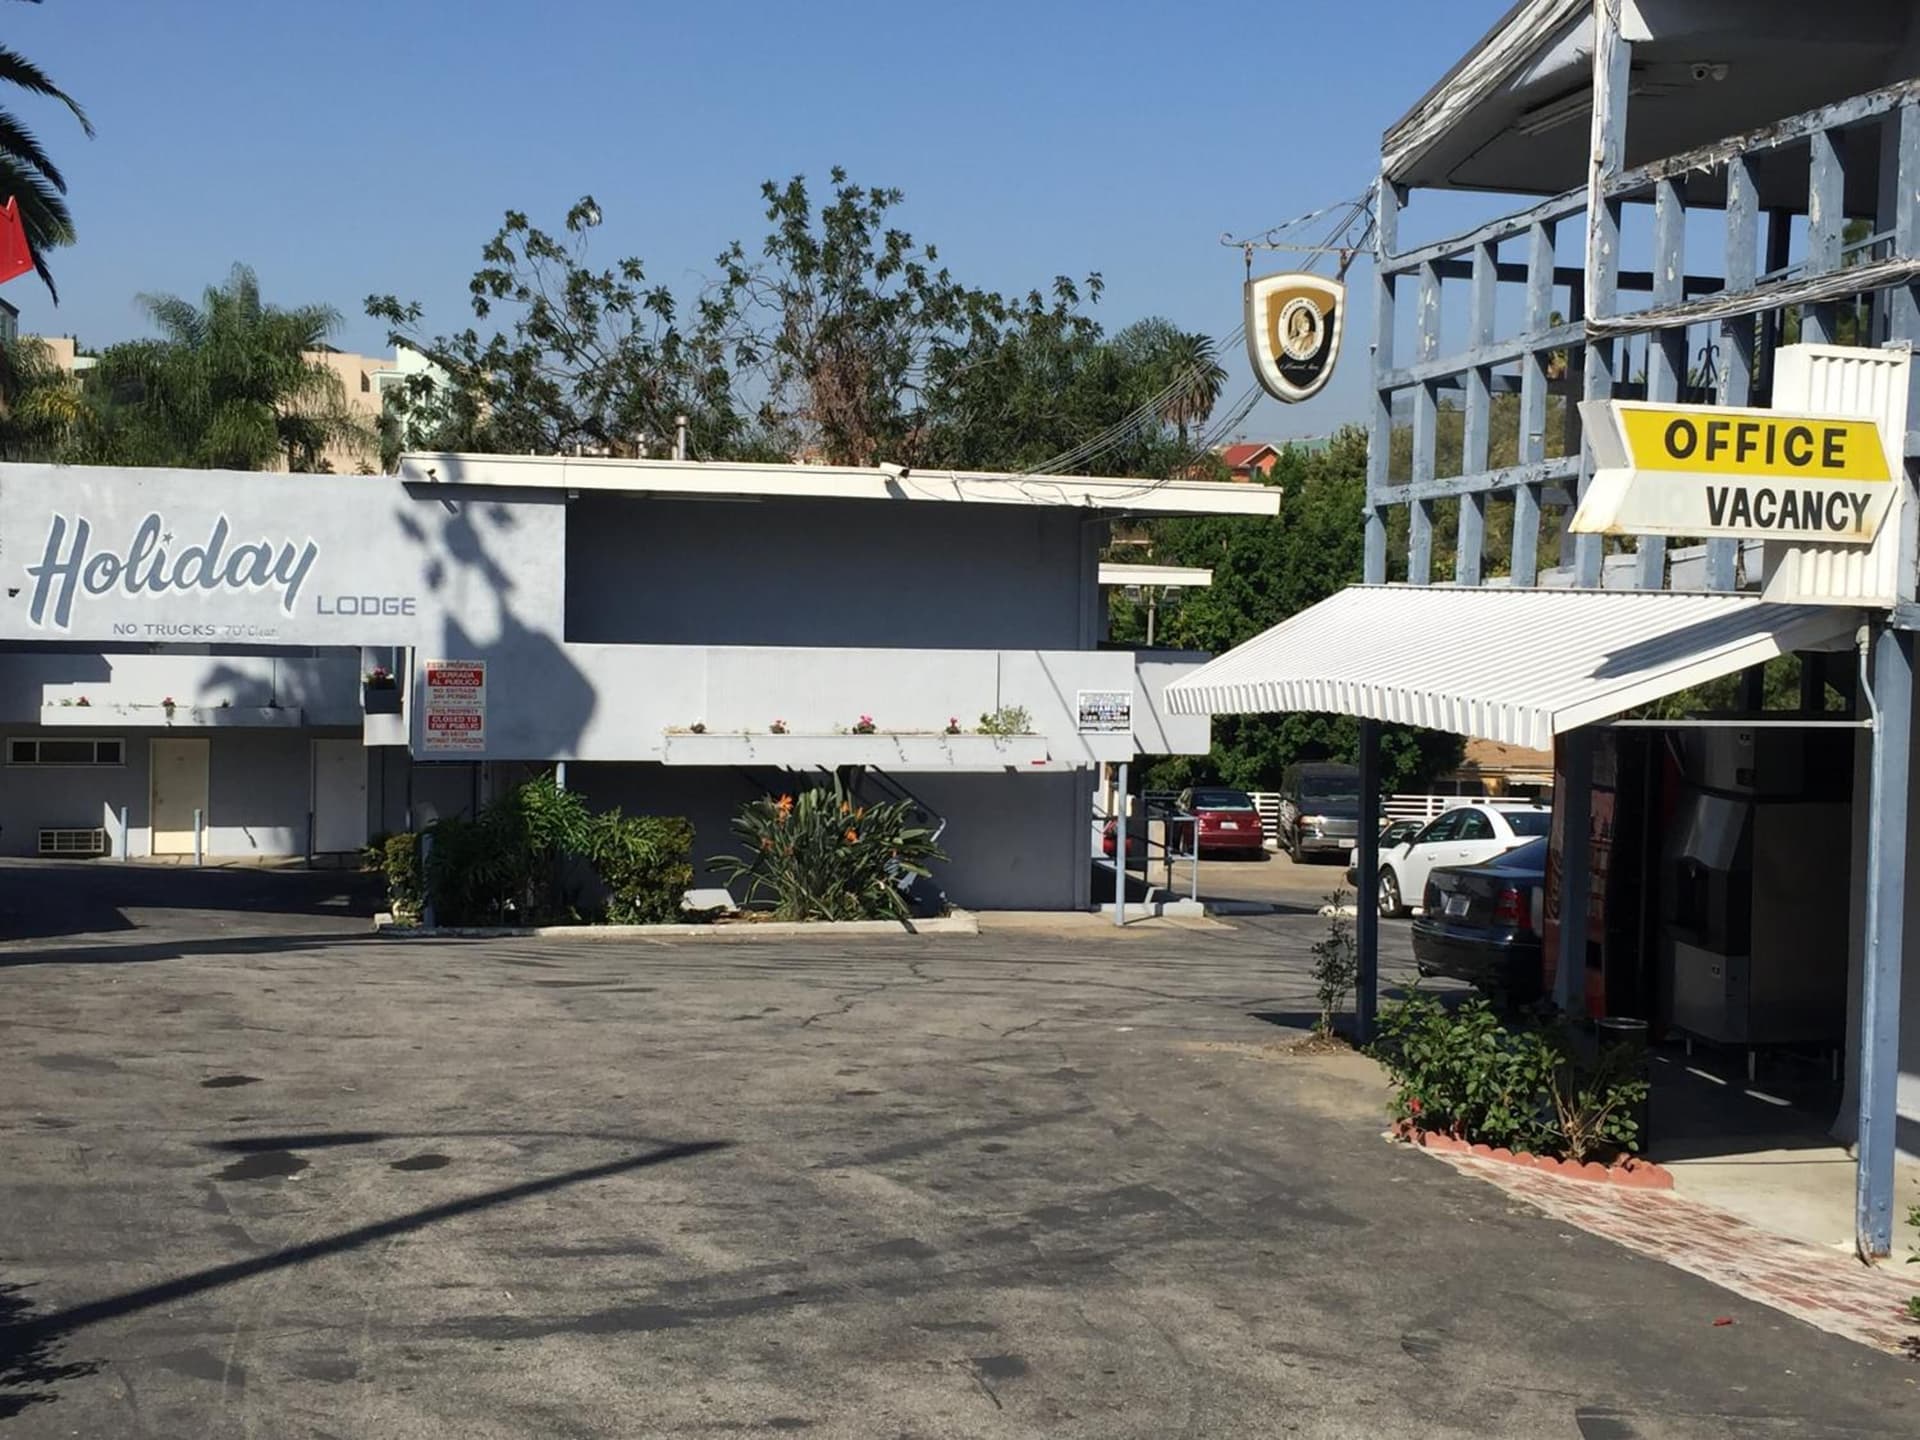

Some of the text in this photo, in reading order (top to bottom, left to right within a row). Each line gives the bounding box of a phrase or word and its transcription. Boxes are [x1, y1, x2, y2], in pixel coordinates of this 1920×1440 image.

[1664, 418, 1847, 468] OFFICE
[1707, 486, 1872, 532] VACANCY
[26, 512, 319, 629] Holiday
[316, 595, 416, 616] LODGE
[113, 623, 137, 635] NO
[144, 623, 216, 636] TRUCKS
